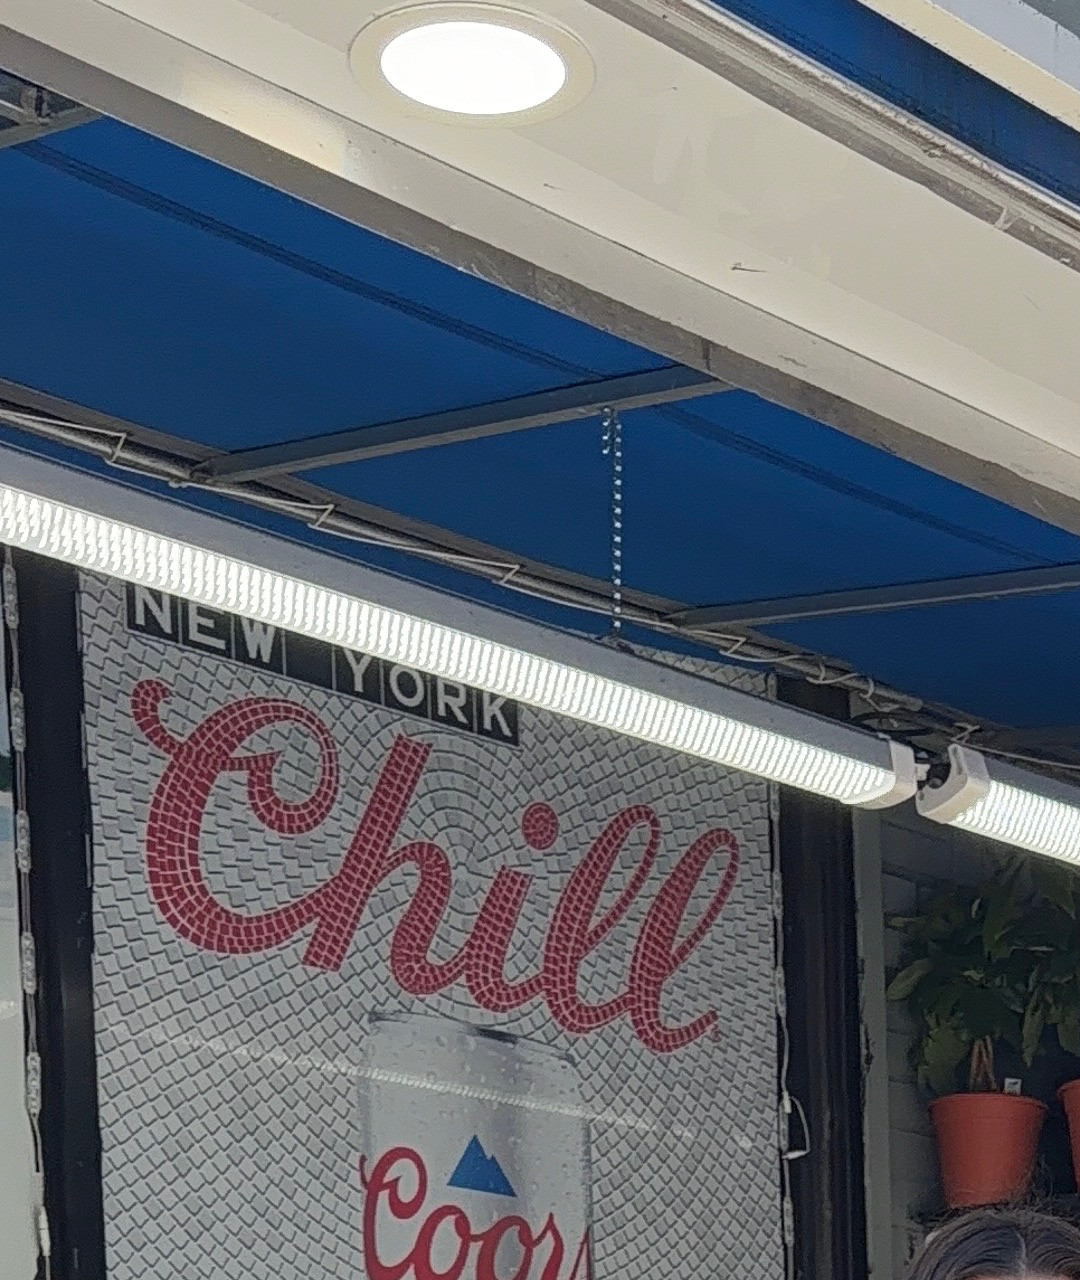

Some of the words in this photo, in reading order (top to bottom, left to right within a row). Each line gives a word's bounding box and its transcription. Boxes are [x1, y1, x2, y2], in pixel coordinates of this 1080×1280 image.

[134, 583, 278, 664] NEW
[343, 647, 513, 738] YORK
[131, 678, 739, 1053] Chill
